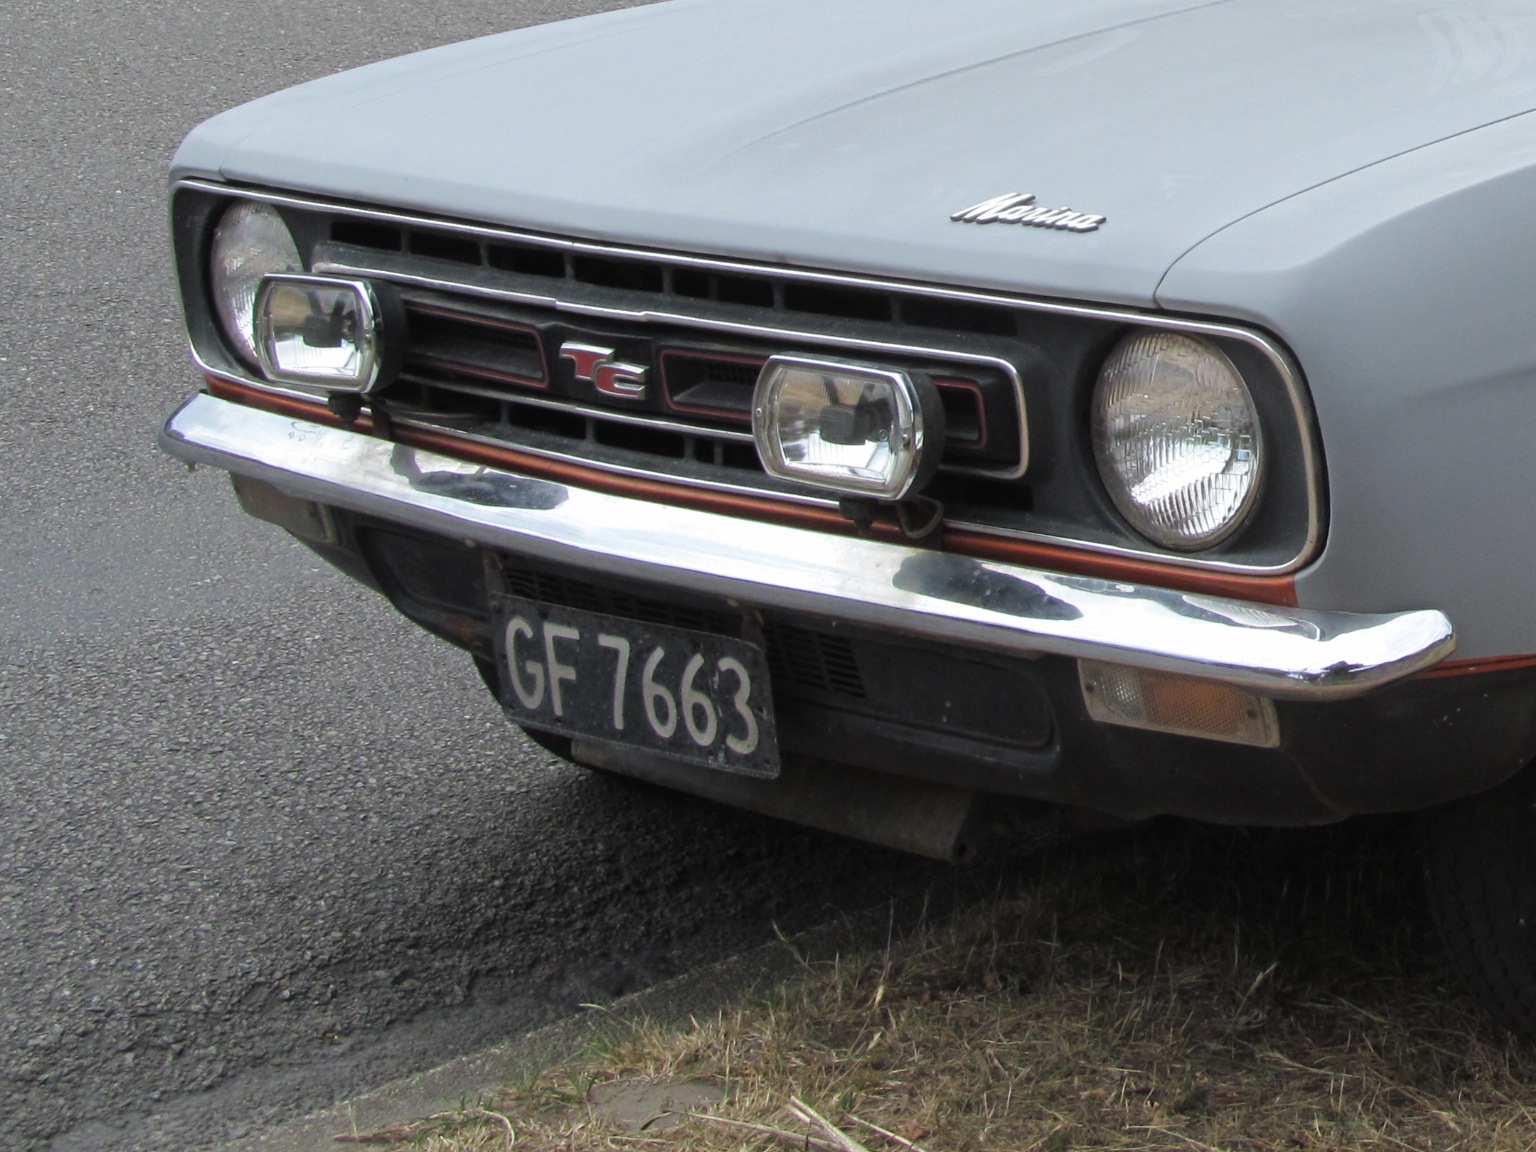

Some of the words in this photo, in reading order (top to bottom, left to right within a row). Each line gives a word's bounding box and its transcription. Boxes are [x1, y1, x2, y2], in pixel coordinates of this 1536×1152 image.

[950, 192, 1107, 233] Marina
[505, 615, 580, 717] GF
[597, 632, 760, 755] 7663
